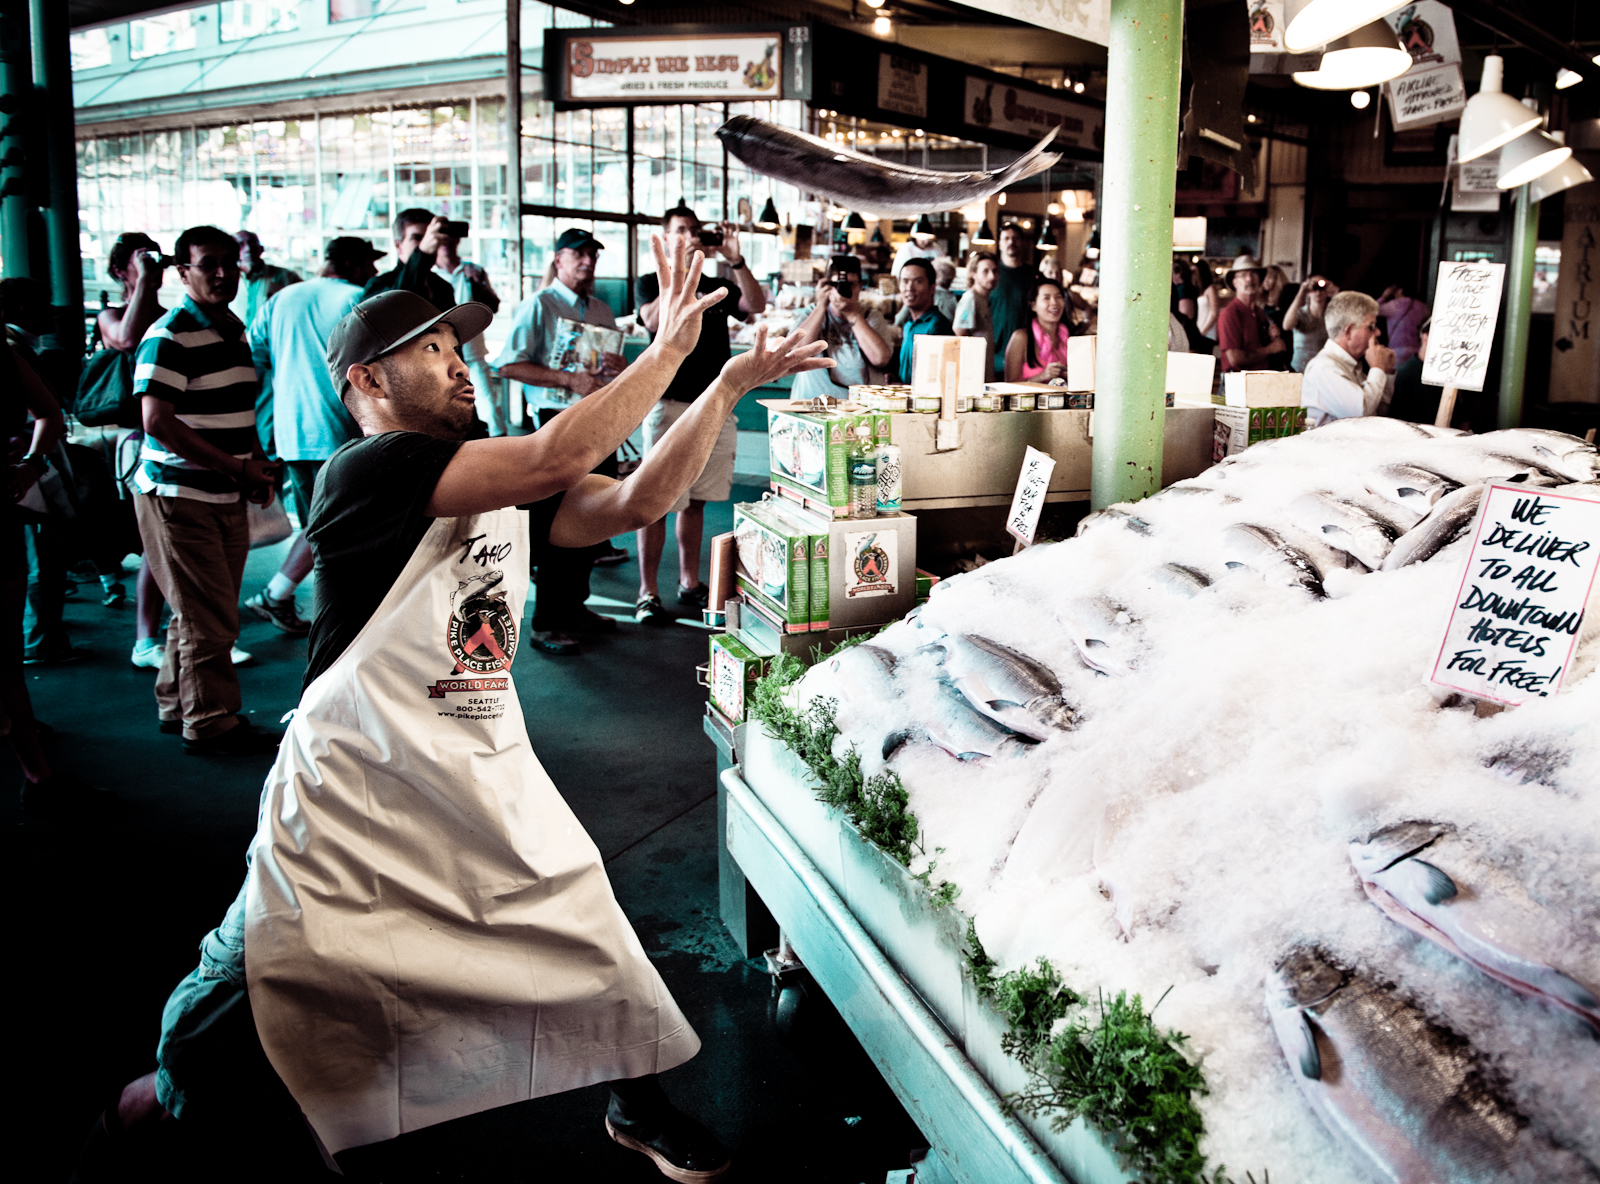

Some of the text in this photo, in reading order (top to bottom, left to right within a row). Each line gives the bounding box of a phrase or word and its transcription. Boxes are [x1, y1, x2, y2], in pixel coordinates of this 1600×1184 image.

[657, 81, 685, 90] FRESH
[688, 80, 729, 89] PRODUCE
[1448, 264, 1494, 283] FRESH
[1447, 294, 1481, 309] WILD
[877, 462, 894, 489] Blue
[1511, 496, 1561, 526] WE
[1481, 521, 1591, 567] DELIVER
[1479, 558, 1558, 592] TO ALL
[1459, 584, 1586, 635] DOWNTOWN
[449, 613, 516, 671] PIKE PLACE FISH MARKET
[1467, 617, 1551, 657] HOTELS
[440, 680, 482, 690] WORLD
[1446, 649, 1562, 698] FOR FREE!
